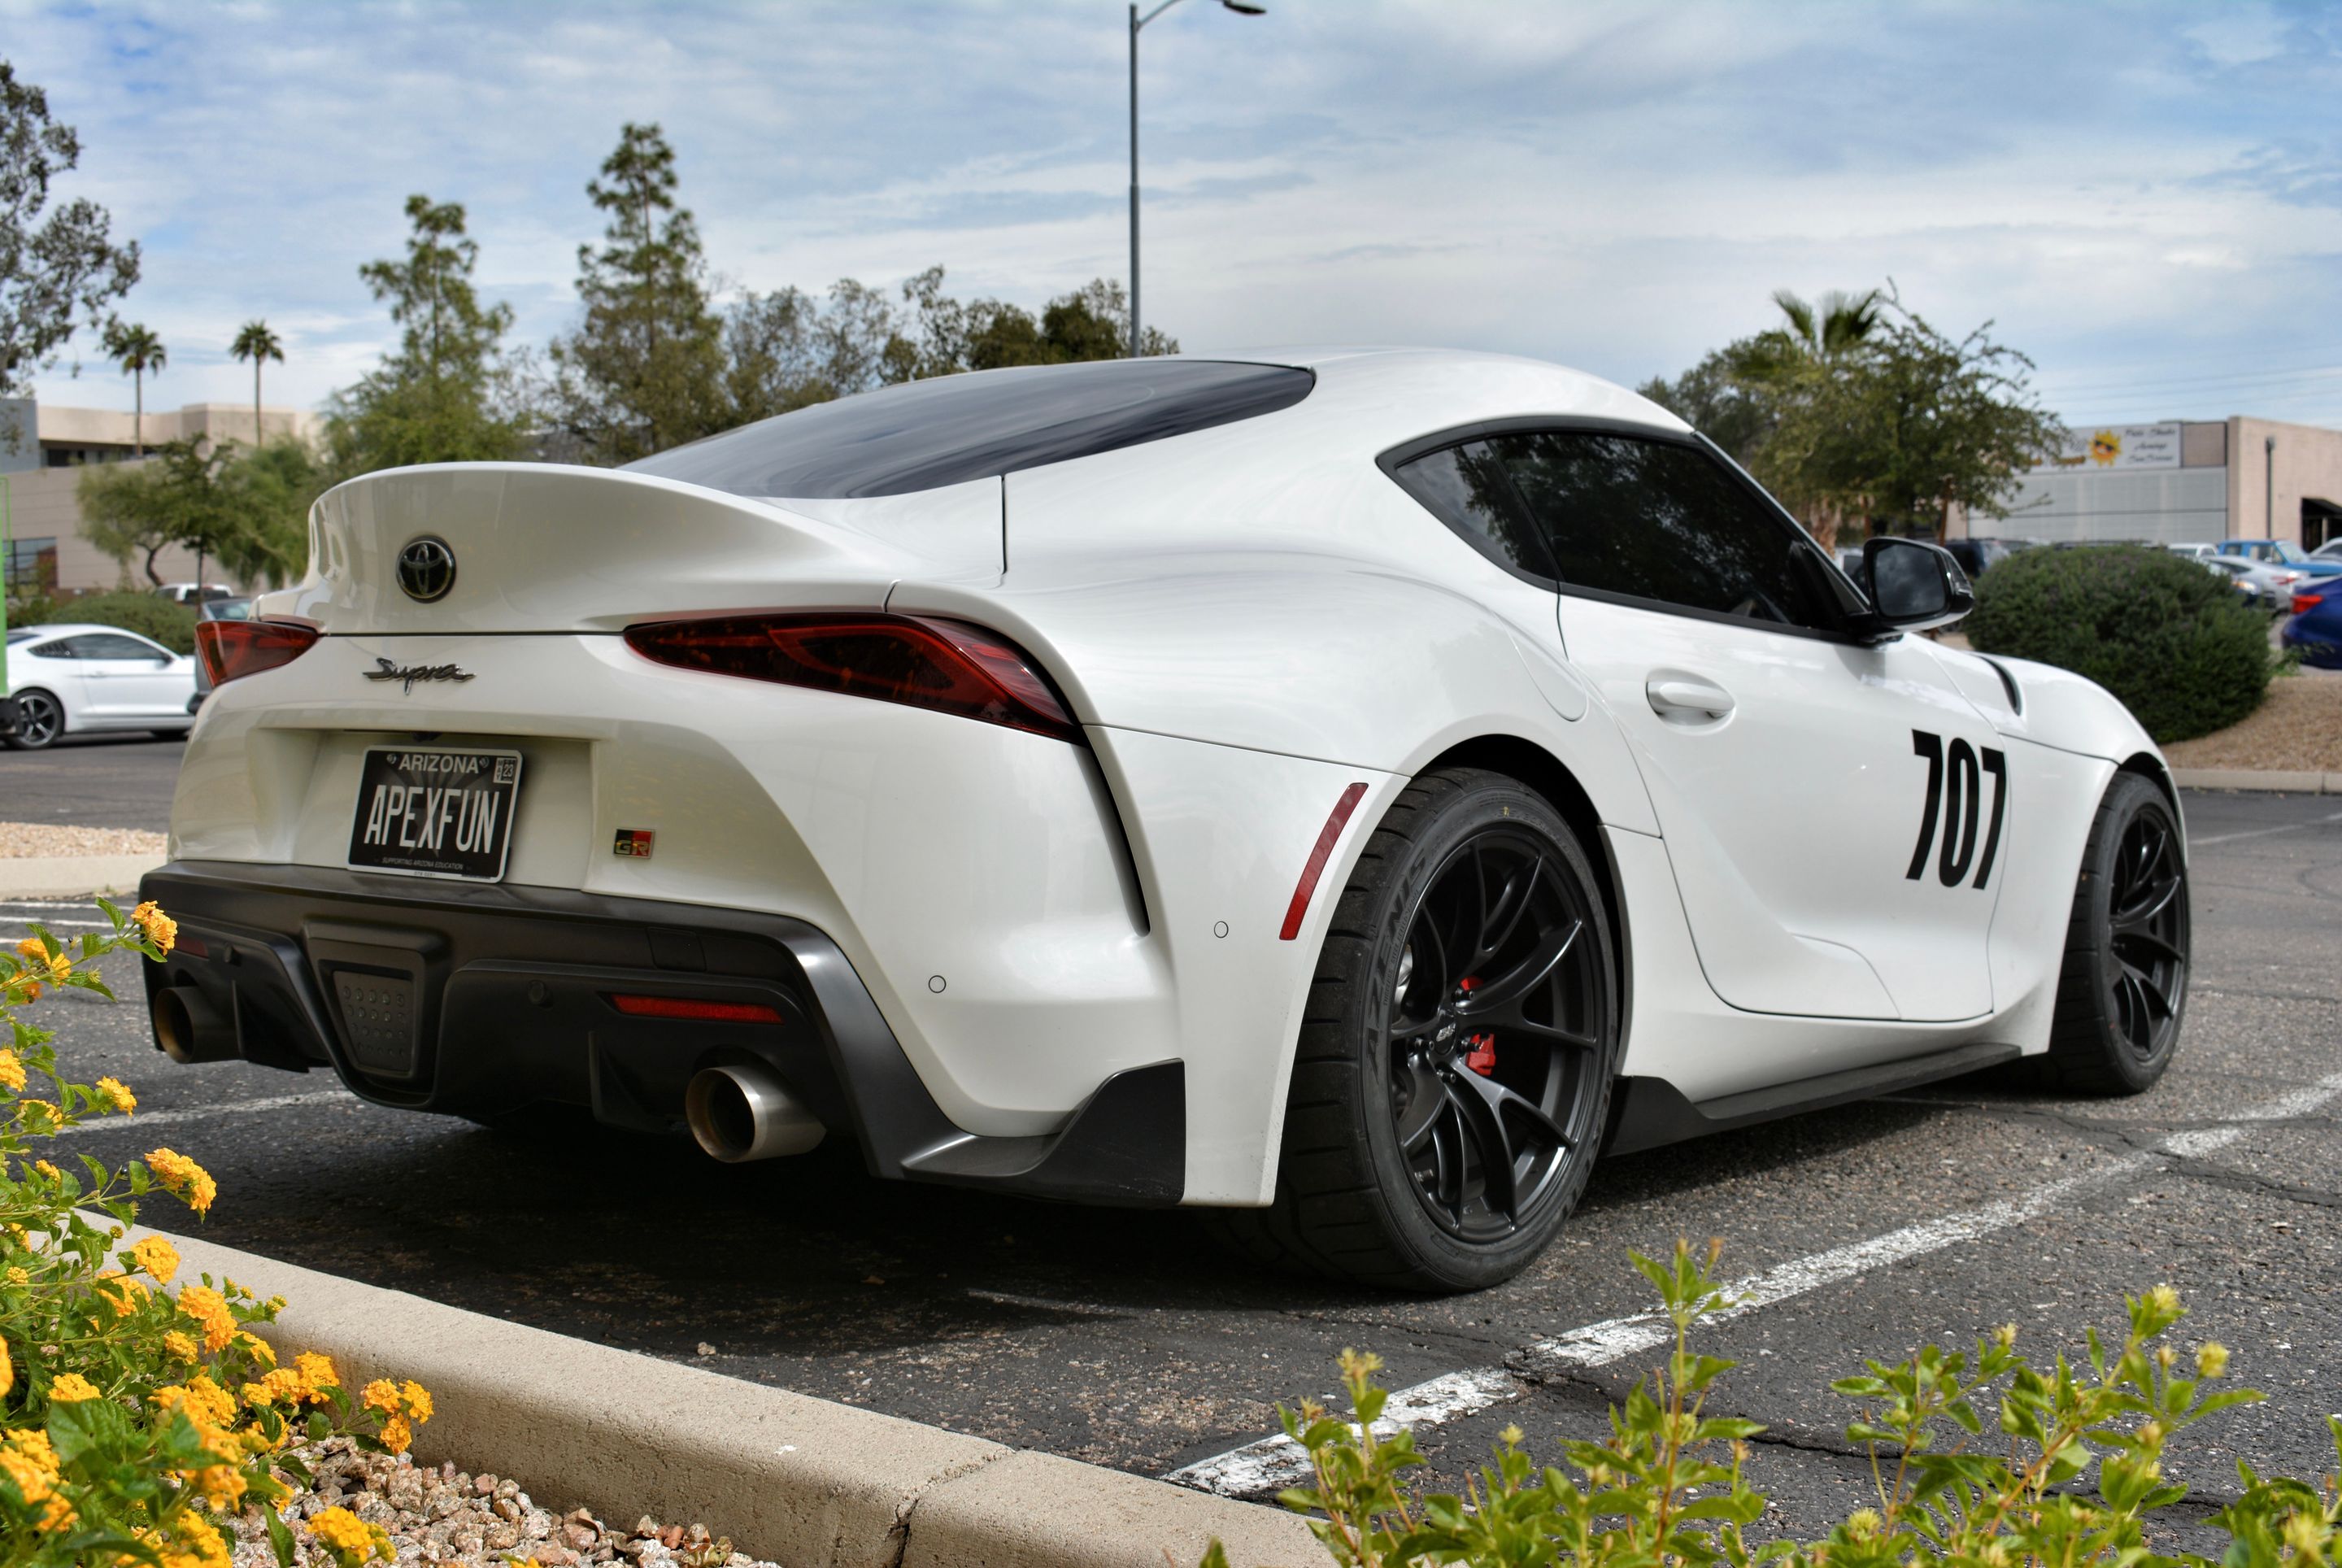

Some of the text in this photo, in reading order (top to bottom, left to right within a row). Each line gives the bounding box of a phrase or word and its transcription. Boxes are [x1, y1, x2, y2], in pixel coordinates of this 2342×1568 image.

[363, 657, 477, 696] Supra
[398, 754, 479, 773] ARIZONA
[503, 764, 514, 777] 23
[1905, 728, 2007, 890] 707
[363, 784, 500, 854] APEXFUN
[615, 839, 650, 856] GR
[382, 856, 464, 870] SUPPORTING ARIZONA EDUCATION
